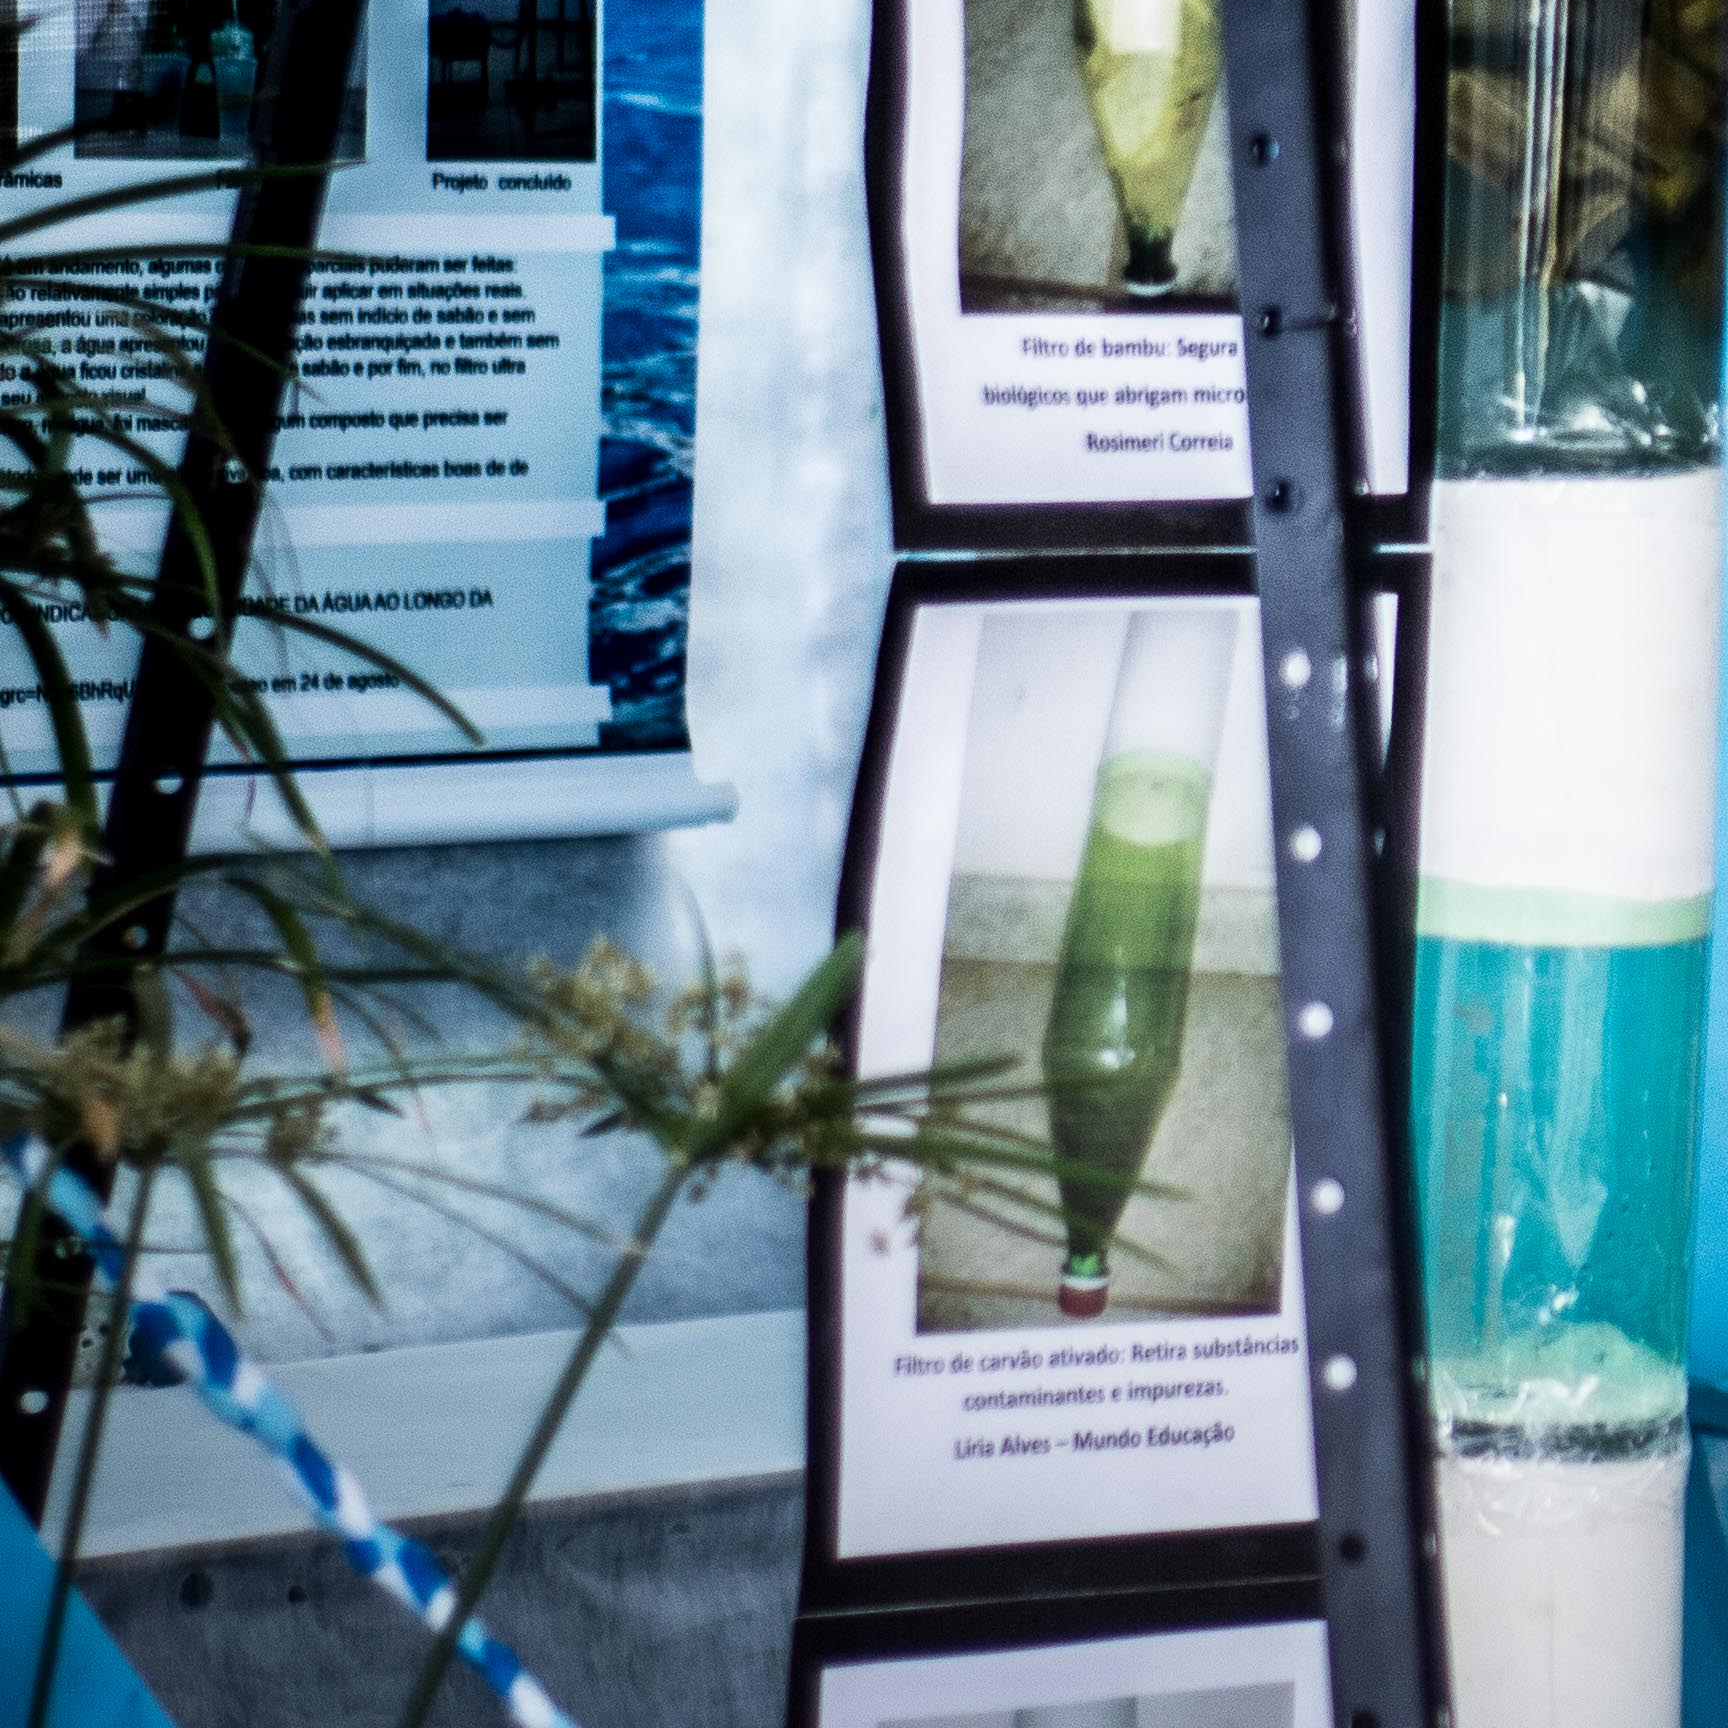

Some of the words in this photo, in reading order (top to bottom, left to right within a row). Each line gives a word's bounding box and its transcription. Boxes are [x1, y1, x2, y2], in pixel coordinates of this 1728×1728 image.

[432, 172, 488, 193] Projeto
[148, 257, 211, 279] algumas
[443, 258, 467, 273] ser
[143, 282, 200, 303] simples
[322, 281, 373, 303] aplicar
[378, 285, 403, 299] em
[320, 310, 353, 325] sem
[412, 306, 432, 324] de
[437, 306, 484, 325] sabão
[488, 310, 498, 324] e
[502, 309, 535, 324] sem
[445, 335, 455, 349] e
[526, 335, 560, 349] sem
[1022, 337, 1069, 357] Filtro
[1074, 338, 1095, 357] de
[1177, 338, 1238, 362] Segura
[80, 360, 117, 380] ficou
[353, 362, 364, 376] e
[367, 361, 392, 381] por
[430, 361, 451, 375] no
[983, 385, 1071, 410] biológicos
[1076, 389, 1108, 408] que
[1115, 385, 1187, 410] abrigam
[388, 412, 419, 432] que
[483, 411, 508, 426] ser
[1086, 430, 1166, 453] Rosimeri
[1169, 430, 1234, 453] Correia
[485, 457, 506, 477] de
[294, 593, 320, 614] DA
[321, 589, 372, 614] ÁGUA
[373, 591, 399, 612] AO
[402, 588, 465, 611] LONGO
[469, 587, 494, 609] DA
[301, 673, 320, 691] 24
[323, 673, 344, 690] de
[893, 1354, 945, 1378] Filtro
[950, 1351, 975, 1373] de
[979, 1348, 1044, 1372] carvão
[1132, 1341, 1187, 1364] Retira
[1192, 1333, 1301, 1360] substâncias
[962, 1385, 1106, 1412] contaminantes
[1110, 1387, 1122, 1403] e
[1000, 1432, 1052, 1456] Alves
[1072, 1426, 1142, 1451] Mundo
[1147, 1419, 1236, 1448] Educação
